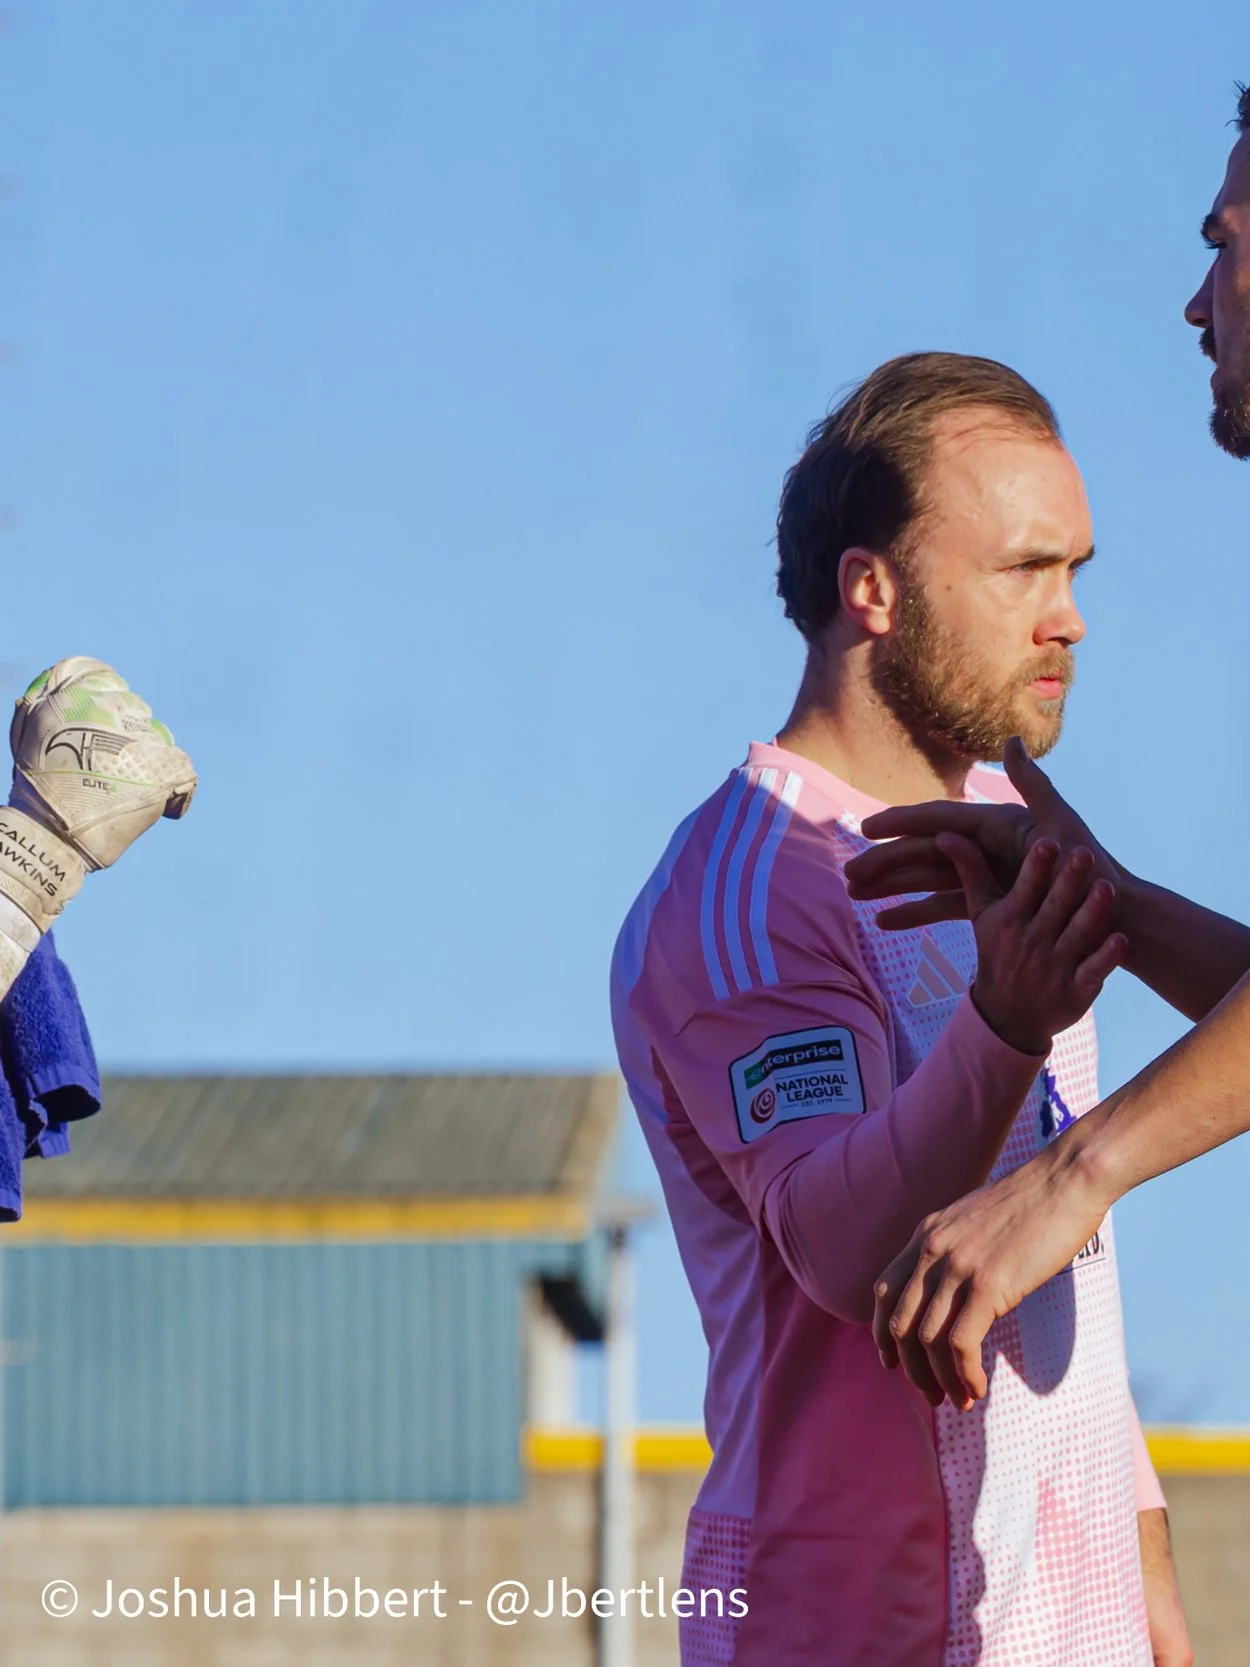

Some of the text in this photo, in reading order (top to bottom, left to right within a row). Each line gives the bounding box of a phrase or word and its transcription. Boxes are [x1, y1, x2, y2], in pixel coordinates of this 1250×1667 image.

[0, 822, 66, 882] CALLUM
[0, 841, 58, 897] WKINS
[747, 1044, 841, 1080] enterprise
[775, 1073, 849, 1093] NATIONAL
[786, 1086, 844, 1102] LEAGUE
